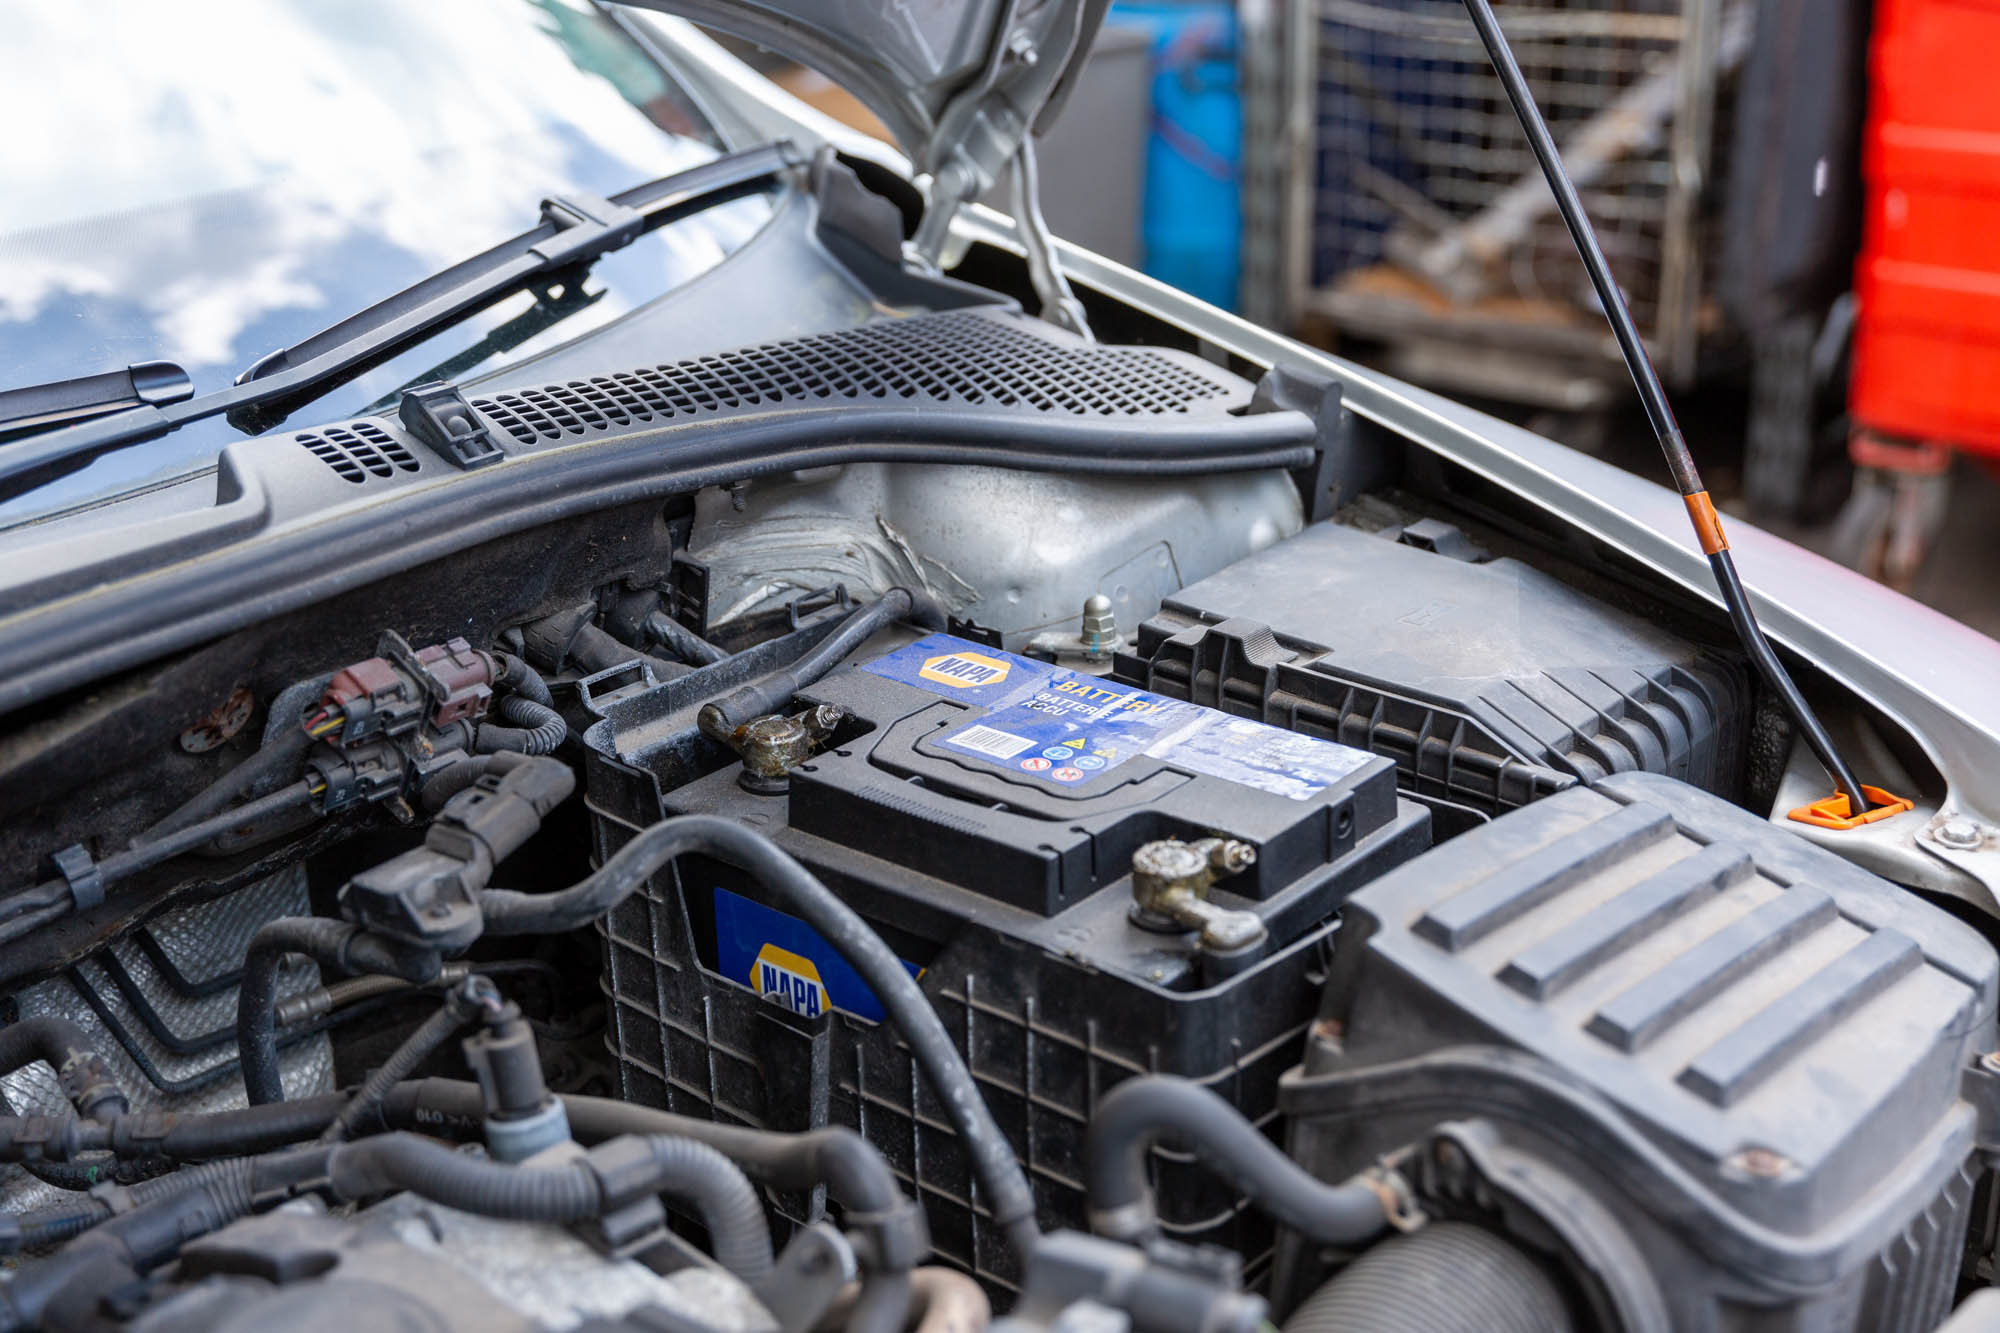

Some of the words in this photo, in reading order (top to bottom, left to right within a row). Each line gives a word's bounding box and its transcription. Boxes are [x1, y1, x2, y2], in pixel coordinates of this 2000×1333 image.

[930, 657, 1000, 683] NAPA
[1020, 699, 1070, 716] ACCU
[762, 963, 821, 1017] NAPA
